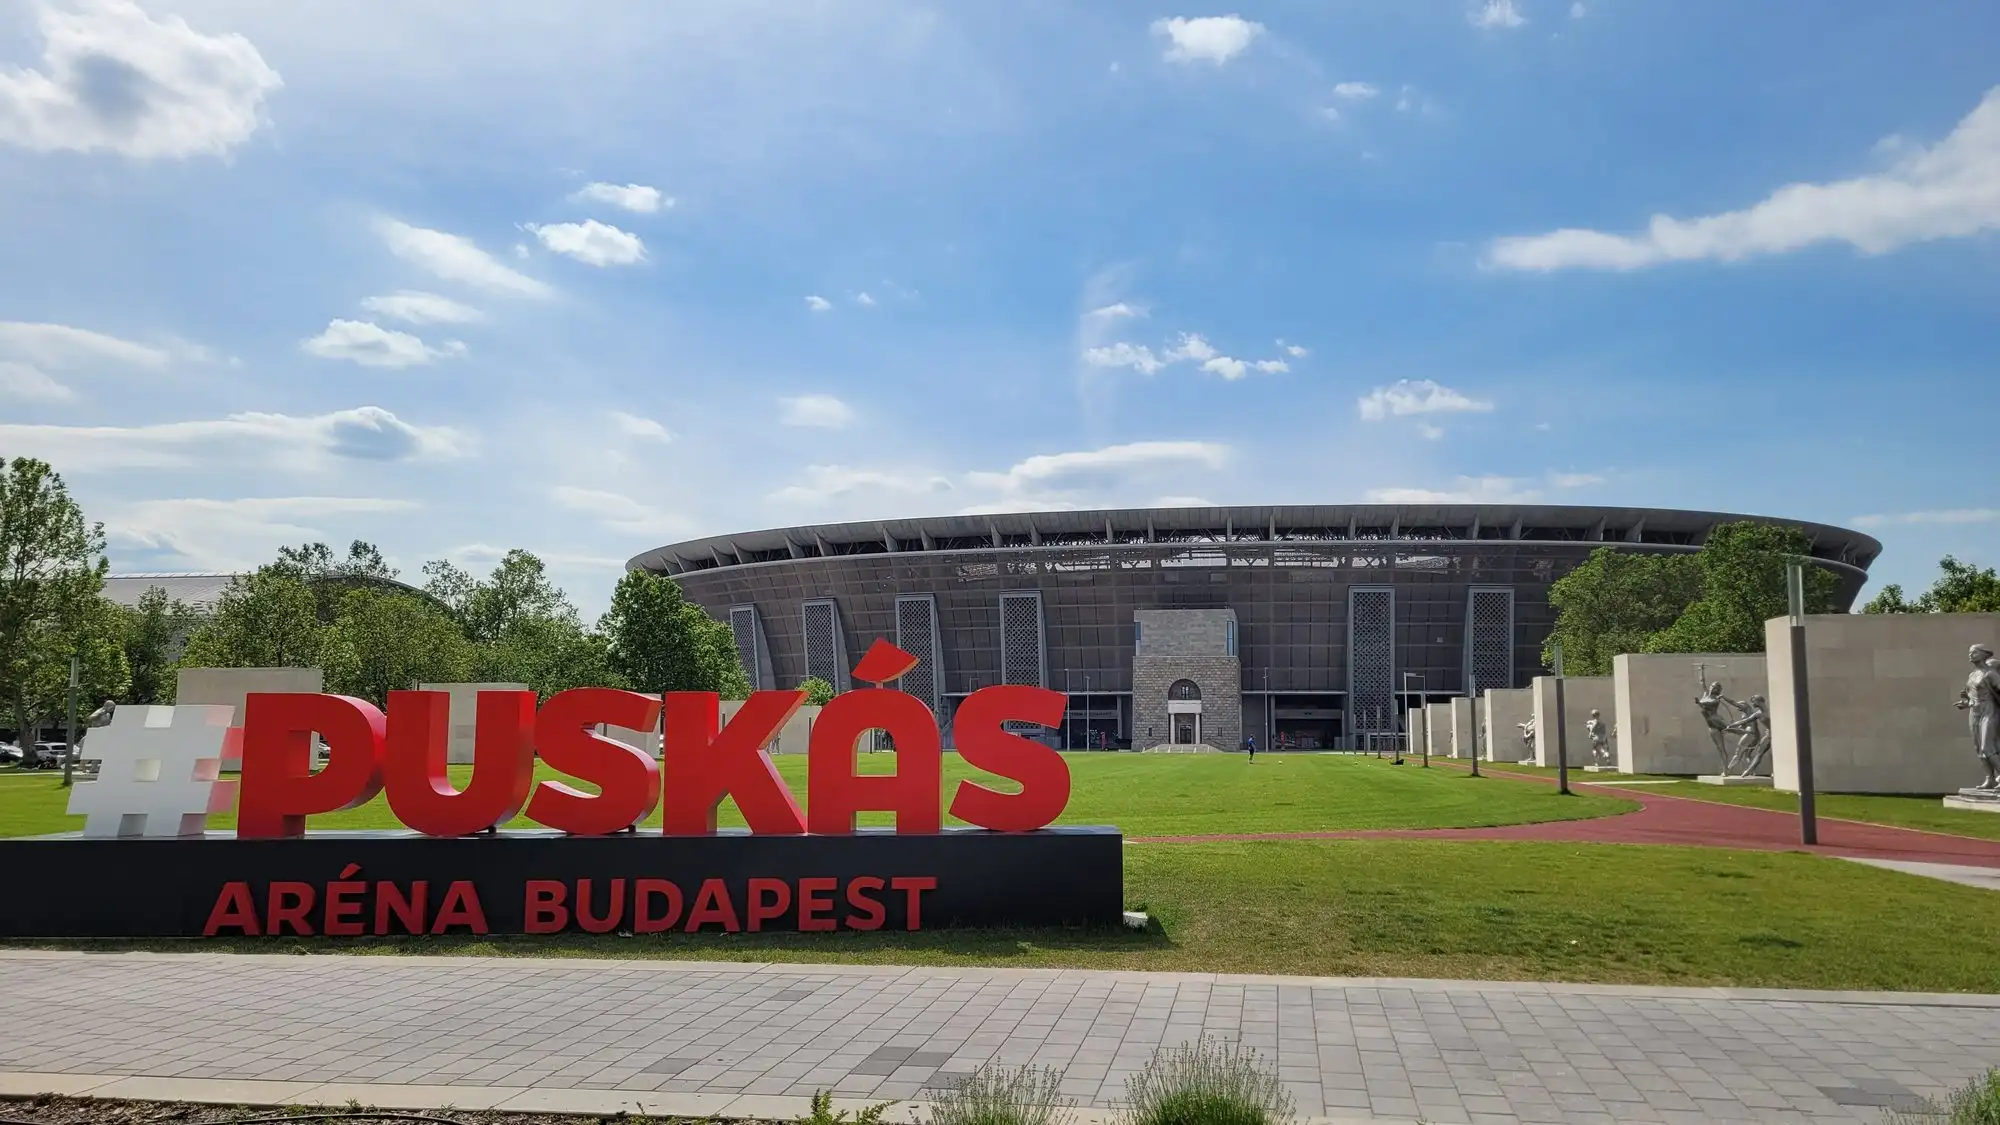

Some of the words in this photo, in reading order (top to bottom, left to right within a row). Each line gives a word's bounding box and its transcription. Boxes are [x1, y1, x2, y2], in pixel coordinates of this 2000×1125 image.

[66, 637, 1071, 839] #PUSKÁS
[203, 862, 489, 937] ARÉNA
[523, 875, 938, 935] BUDAPEST
